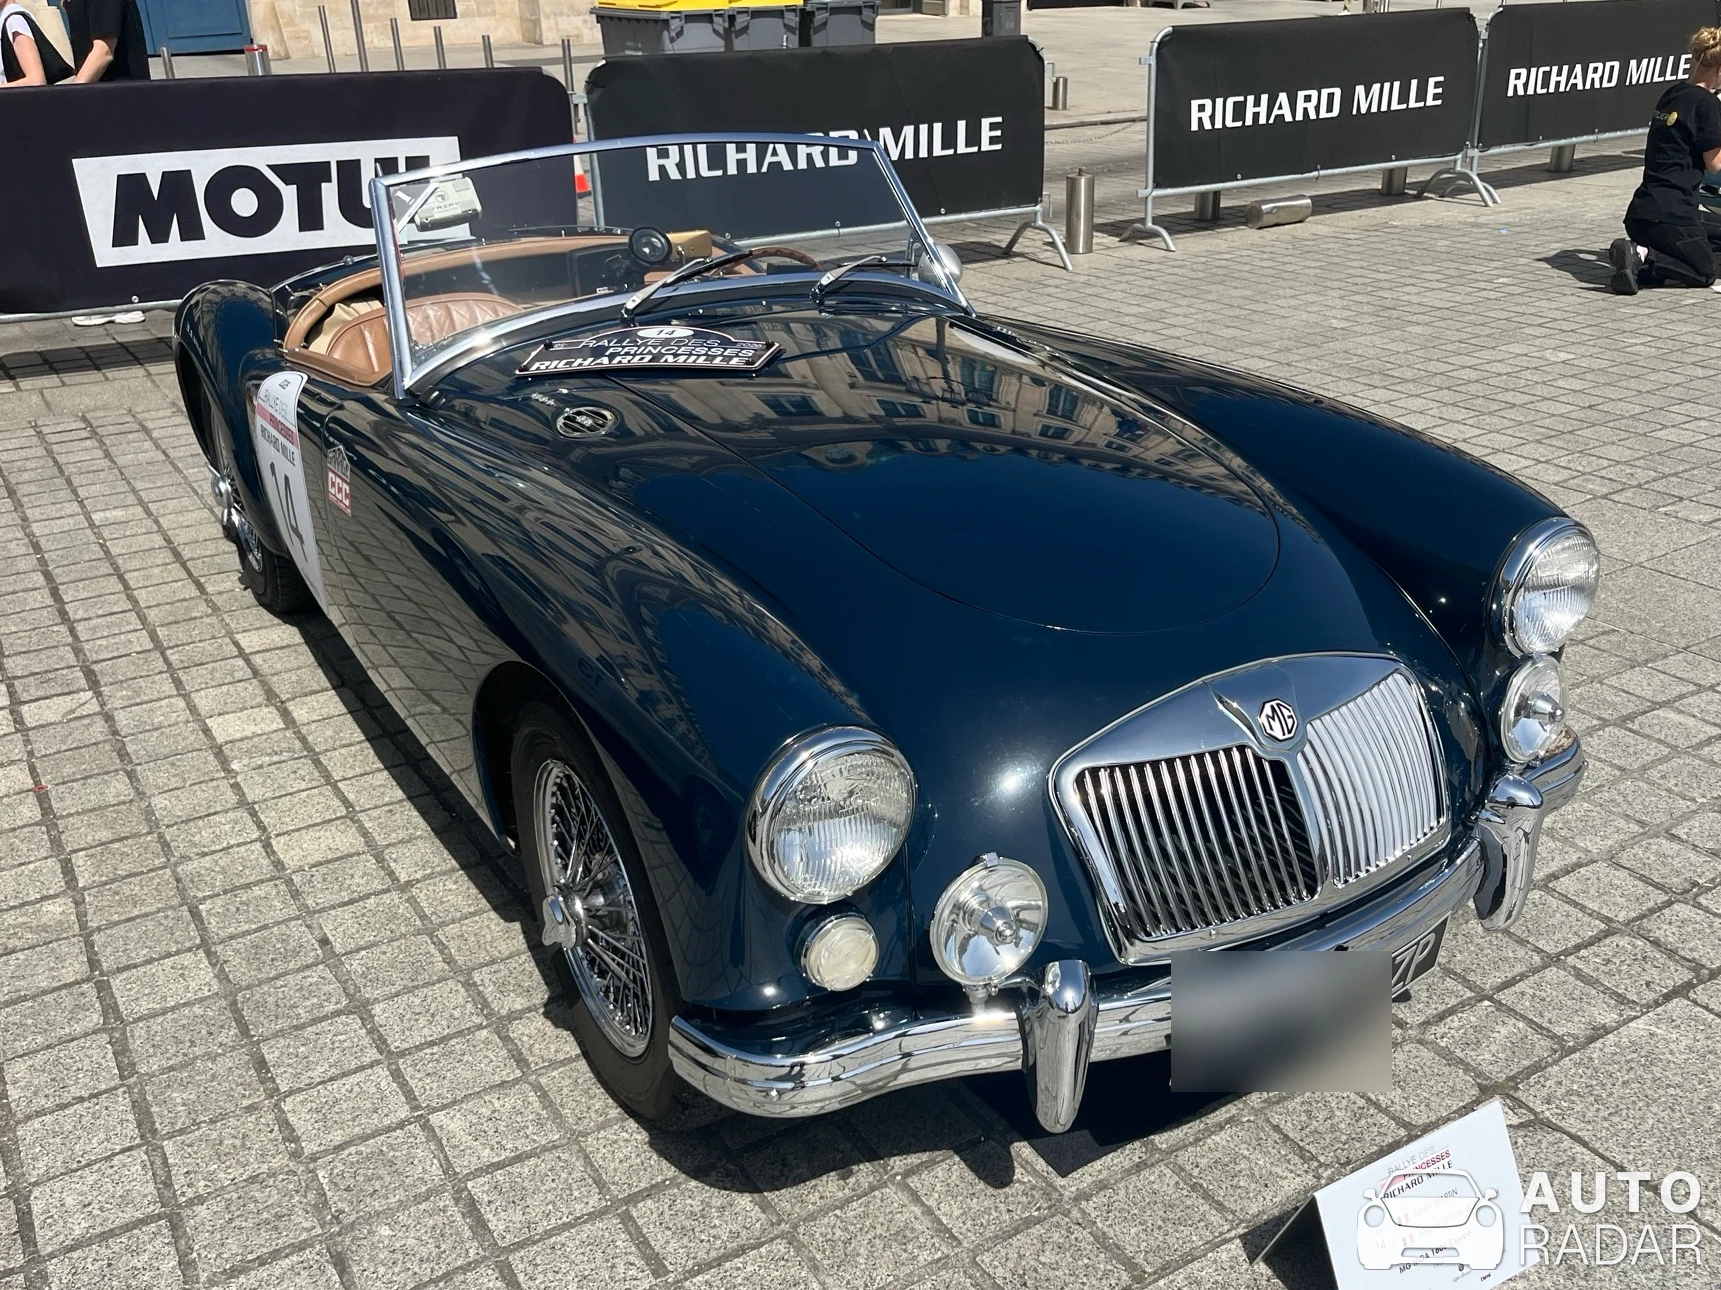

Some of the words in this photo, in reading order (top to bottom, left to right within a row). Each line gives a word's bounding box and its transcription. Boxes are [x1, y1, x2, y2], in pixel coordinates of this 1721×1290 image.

[1507, 60, 1619, 98] RICHARD
[1625, 53, 1692, 87] MILLE
[1190, 87, 1341, 131] RICHARD
[1352, 76, 1444, 116] MILLE
[646, 130, 858, 182] RICHARD
[879, 117, 1002, 161] MILLE
[579, 338, 665, 348] RALLYE
[670, 338, 721, 347] DES
[605, 346, 755, 357] PRINCESSES
[529, 355, 653, 371] RICHARD
[660, 354, 749, 365] MILLE
[328, 470, 350, 507] CCC
[269, 461, 308, 564] 14
[1265, 702, 1296, 737] MG
